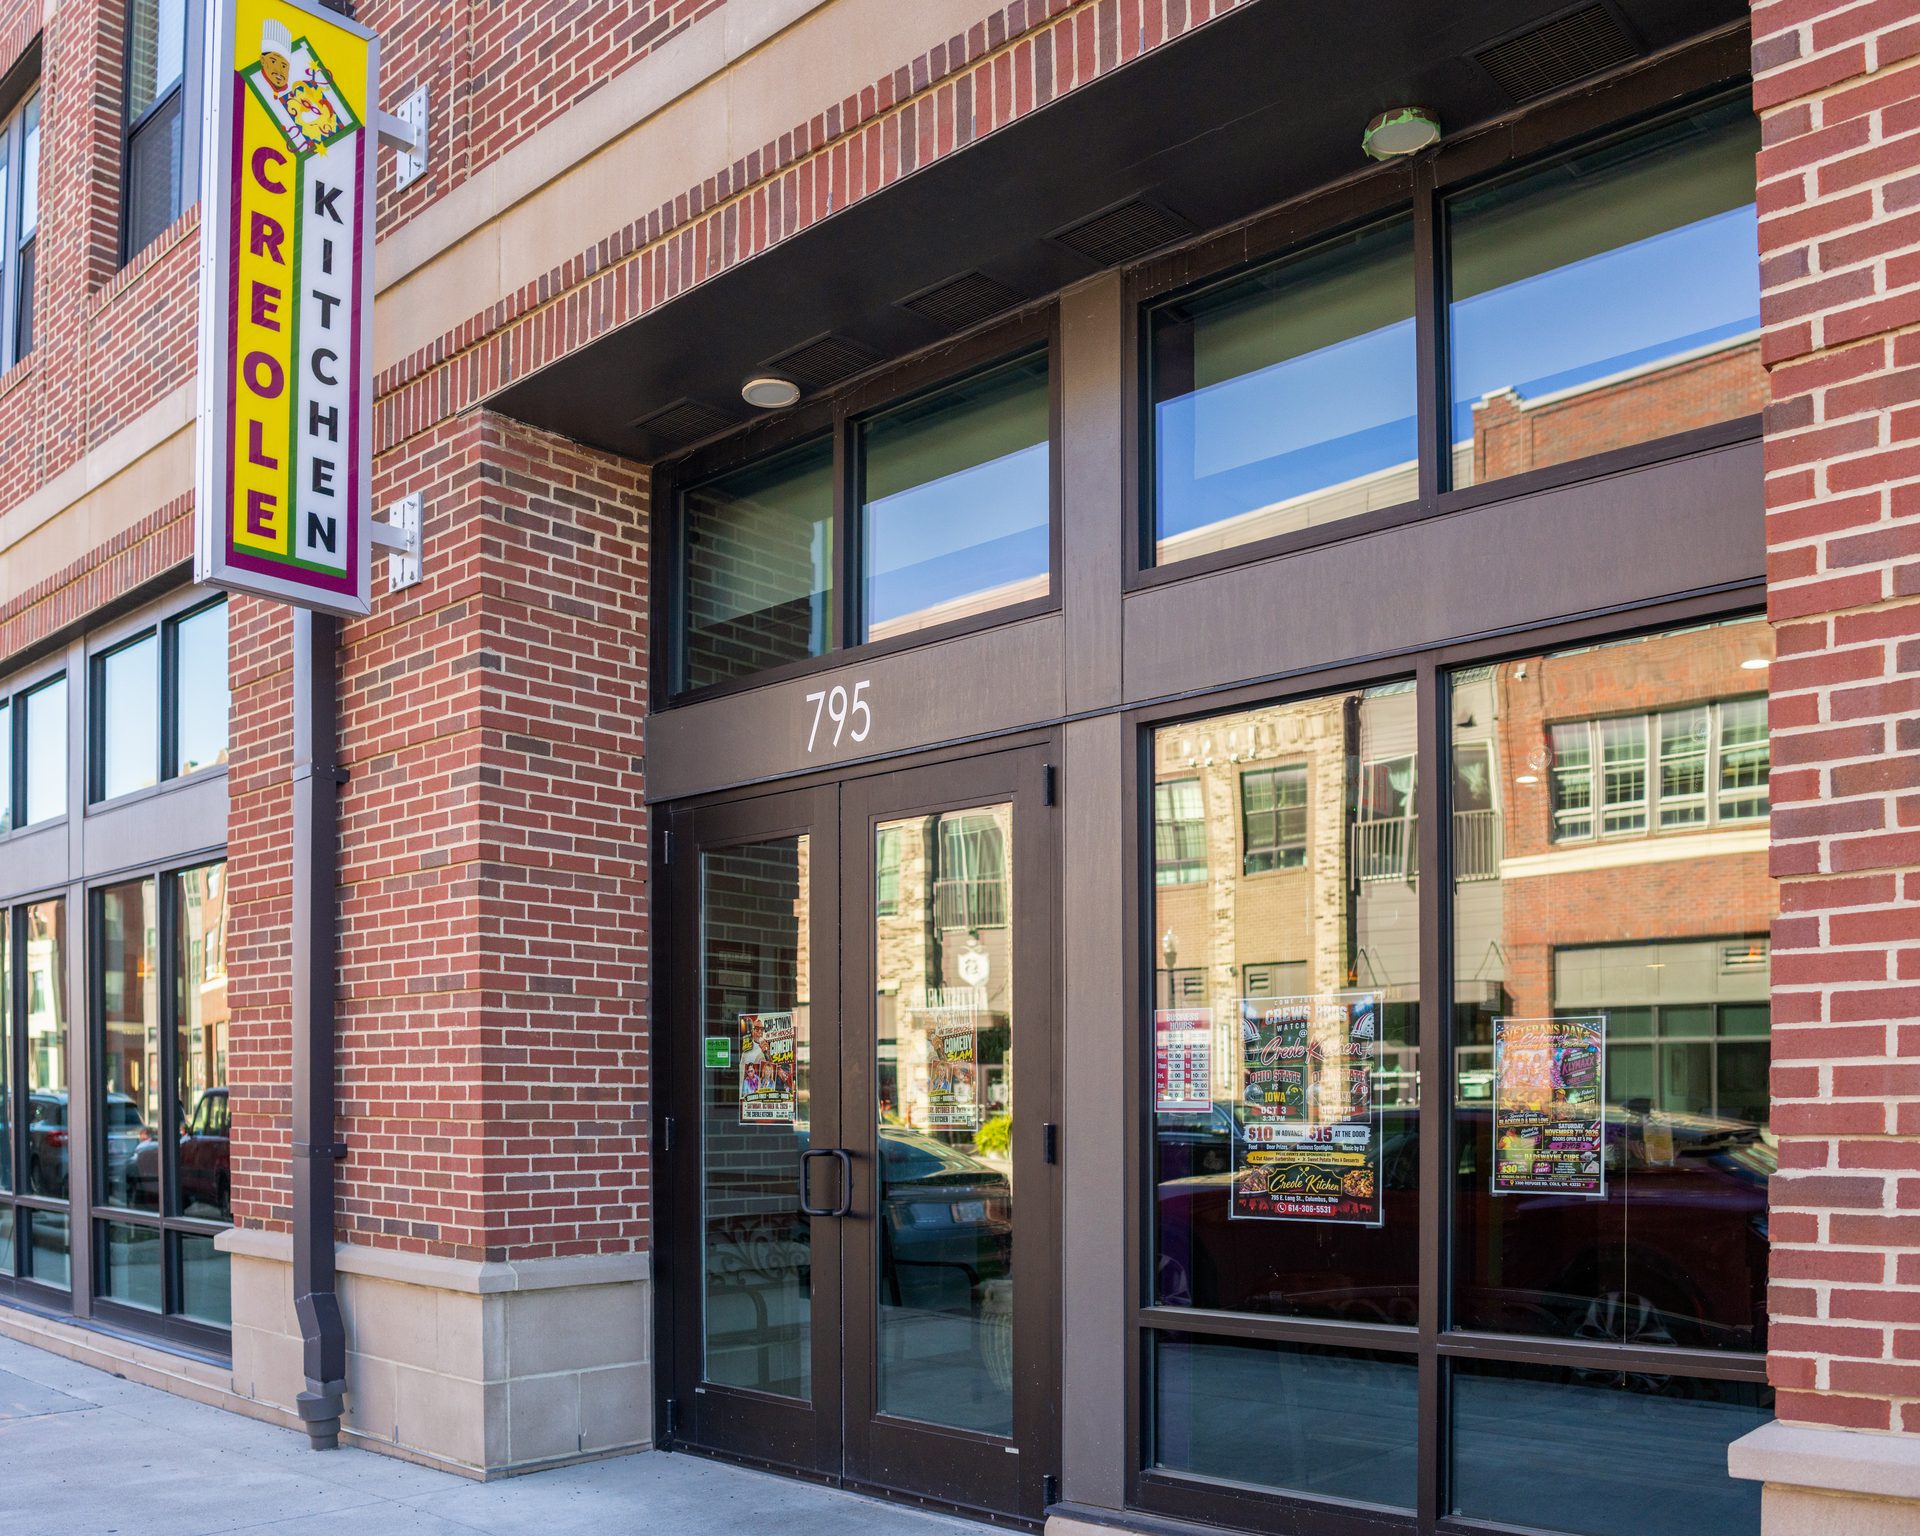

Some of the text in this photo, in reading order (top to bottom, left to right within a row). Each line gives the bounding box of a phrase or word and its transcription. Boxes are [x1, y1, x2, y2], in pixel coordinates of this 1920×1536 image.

[243, 146, 286, 540] CREOLE
[307, 180, 344, 555] KITCHEN
[806, 680, 872, 753] 795
[1265, 1005, 1311, 1026] CREWS
[954, 1024, 972, 1032] HOUSE
[1506, 1024, 1583, 1040] VETERANS DAY
[770, 1038, 794, 1056] COMEDY
[944, 1034, 972, 1054] COMEDY
[1261, 1035, 1306, 1065] Creole
[773, 1051, 793, 1063] SLAM
[947, 1049, 972, 1061] SLAM
[1562, 1056, 1594, 1074] KLYMAXX
[1250, 1069, 1301, 1084] OHIO STATE
[1264, 1091, 1286, 1103] IOWA
[1261, 1106, 1277, 1115] OCT
[1248, 1126, 1273, 1141] $10
[1281, 1129, 1304, 1137] ADVANCE
[1307, 1126, 1366, 1142] $15 AT THE DOOR
[1545, 1129, 1574, 1137] NOVEMBER
[1502, 1164, 1517, 1174] $30
[1270, 1174, 1339, 1193] Creole Kitchen
[1288, 1205, 1331, 1213] 614-306-5531
